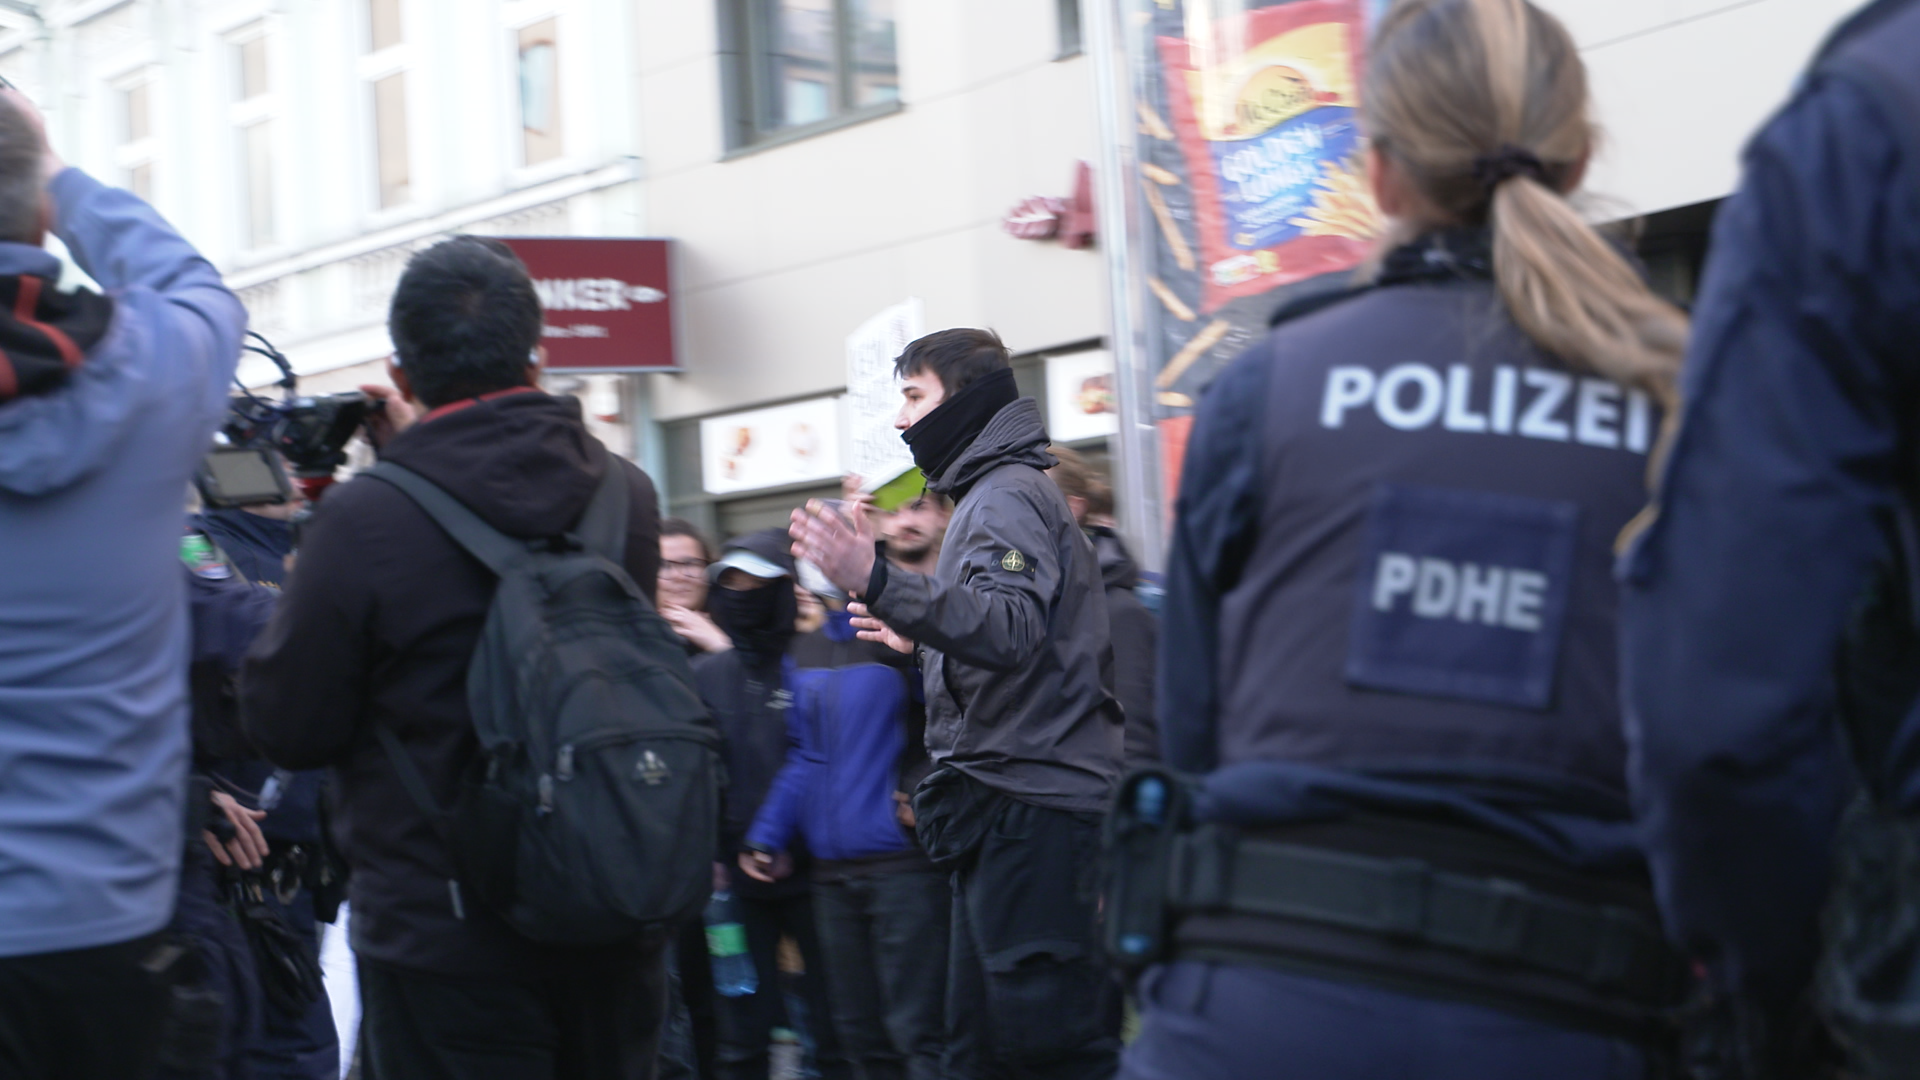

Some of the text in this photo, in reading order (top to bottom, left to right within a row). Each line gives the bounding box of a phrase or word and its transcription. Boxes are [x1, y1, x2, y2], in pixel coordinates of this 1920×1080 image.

[530, 277, 632, 312] NKER
[1321, 363, 1650, 453] POLIZEI
[1373, 553, 1546, 631] PDHE
